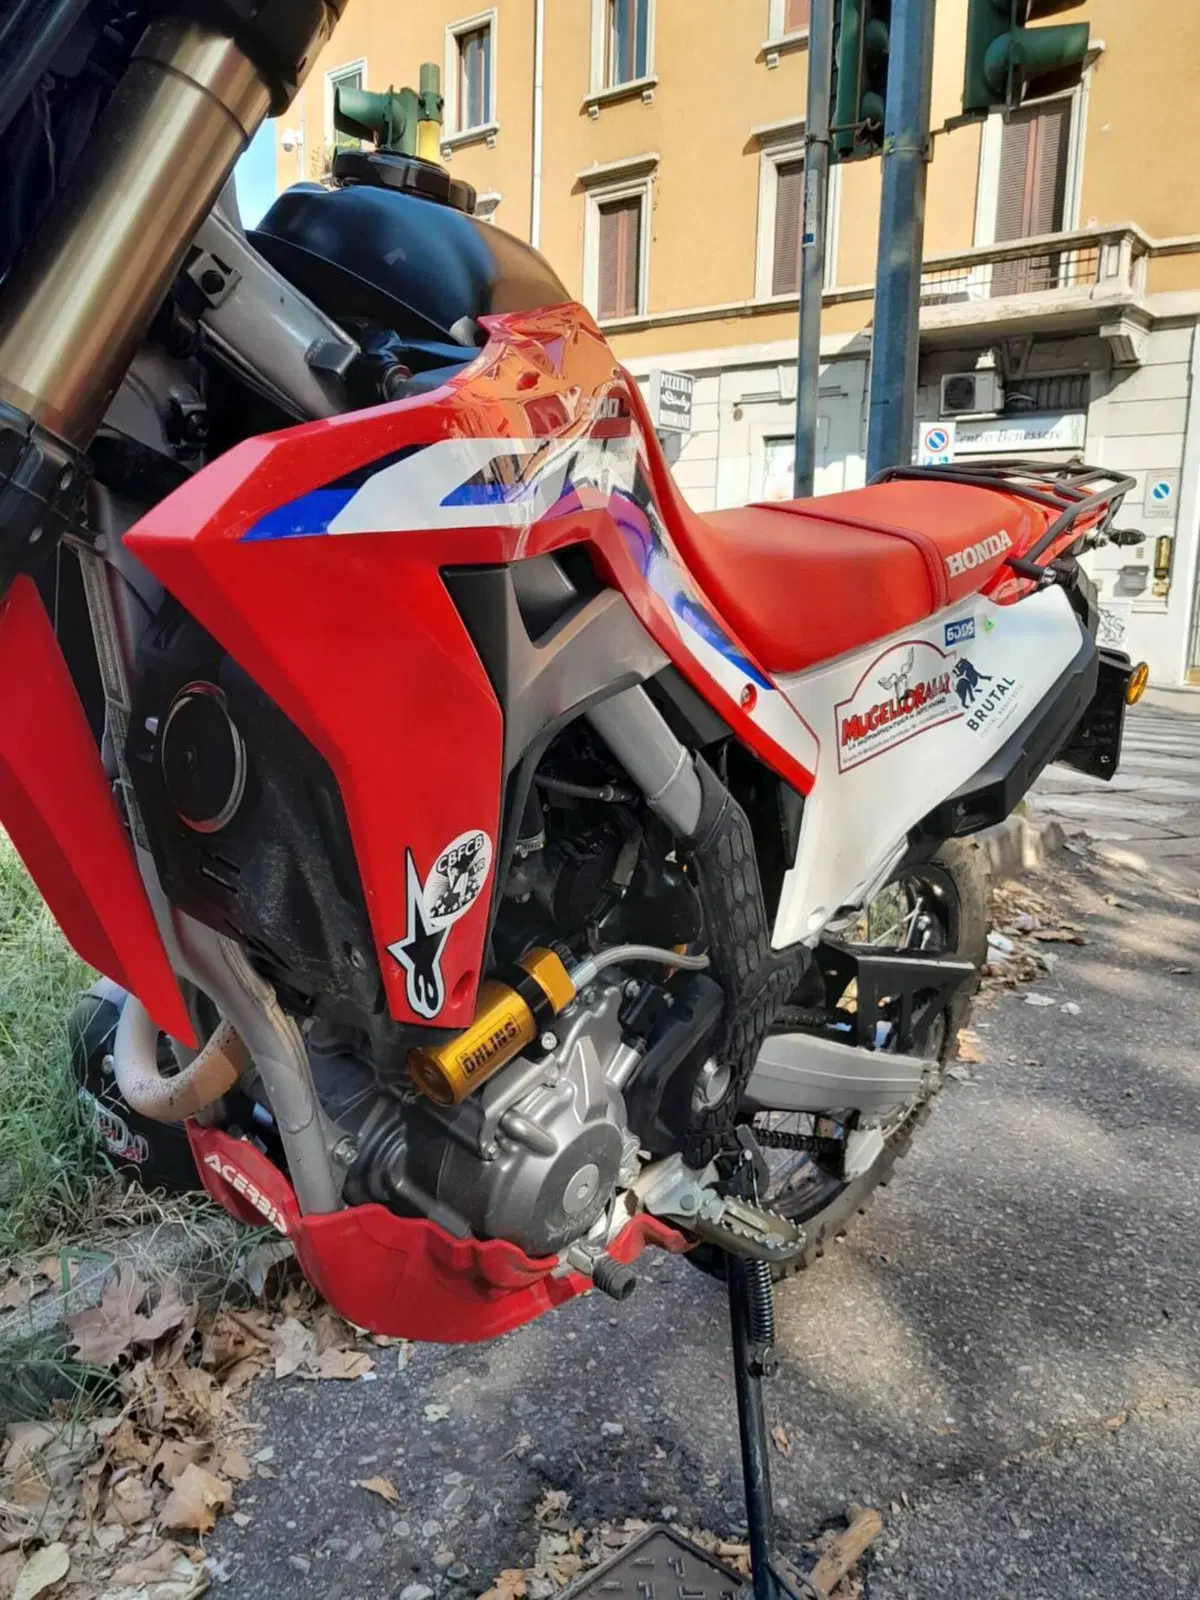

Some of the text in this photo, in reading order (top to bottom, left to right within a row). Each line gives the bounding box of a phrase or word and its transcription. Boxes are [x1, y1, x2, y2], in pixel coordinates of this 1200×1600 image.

[660, 373, 692, 393] PIZZERIA
[998, 428, 1063, 443] Benessere
[945, 529, 1013, 578] HONDA
[966, 677, 1016, 732] BRUTAL
[436, 833, 484, 875] CBFCB
